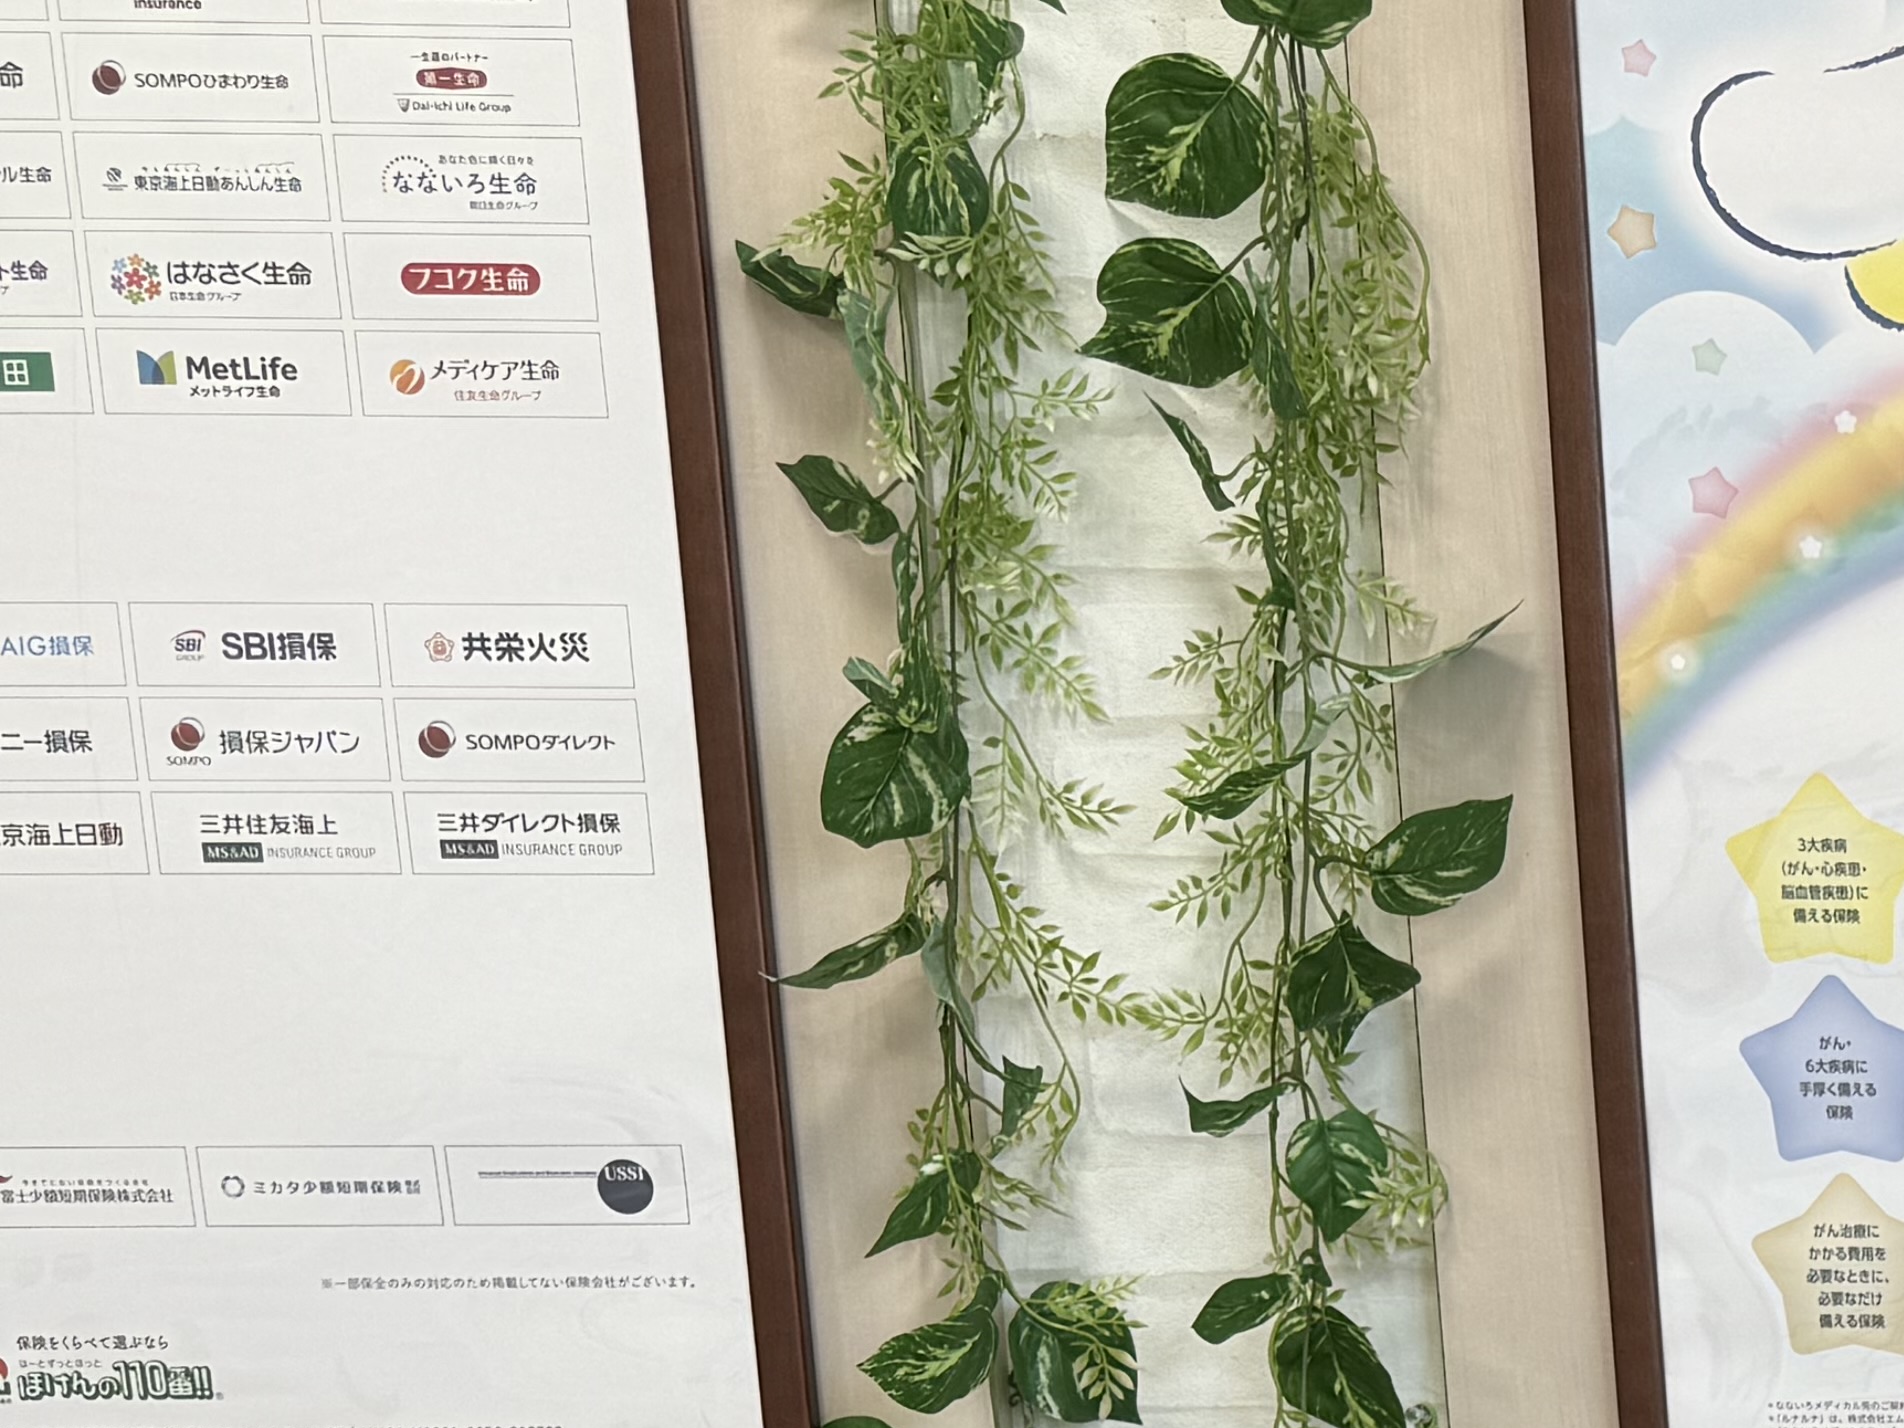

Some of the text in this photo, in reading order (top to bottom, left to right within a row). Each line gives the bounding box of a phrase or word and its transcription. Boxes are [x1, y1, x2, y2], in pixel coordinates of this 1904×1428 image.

[134, 72, 289, 89] SOMPOひまわり生命
[392, 172, 538, 196] なないろ生命
[167, 261, 312, 286] はなさく生命
[410, 265, 531, 294] フコク生命
[186, 356, 298, 381] MetLife
[430, 358, 560, 382] メディケア生命
[1, 635, 95, 656] AIG損保
[221, 631, 338, 663] SBI損保
[462, 632, 591, 663] 共栄火災
[218, 729, 360, 756] 損保ジャパン
[465, 732, 617, 752] SOMPOダイレクト
[200, 813, 338, 835] 三井住友海上
[437, 812, 621, 834] 三井ダイレクト損保
[0, 822, 124, 847] 京海上日動
[267, 846, 333, 859] INSURANCE
[336, 847, 377, 859] GROUP
[501, 843, 579, 858] INSURANCE
[582, 843, 623, 858] GROUP
[1797, 837, 1848, 854] 3大疾病
[1792, 907, 1861, 925] 備える保険
[1804, 1058, 1869, 1075] 6大疾病に
[1799, 1081, 1877, 1099] 手厚く備える
[1826, 1104, 1854, 1121] 保険
[603, 1165, 645, 1182] USSI
[1813, 1222, 1880, 1240] がん治療に
[1808, 1245, 1887, 1263] かかる費用を
[1806, 1268, 1891, 1285] 必要なときに、
[1817, 1290, 1884, 1308] 必要なだけ
[1818, 1312, 1887, 1330] 備える保険
